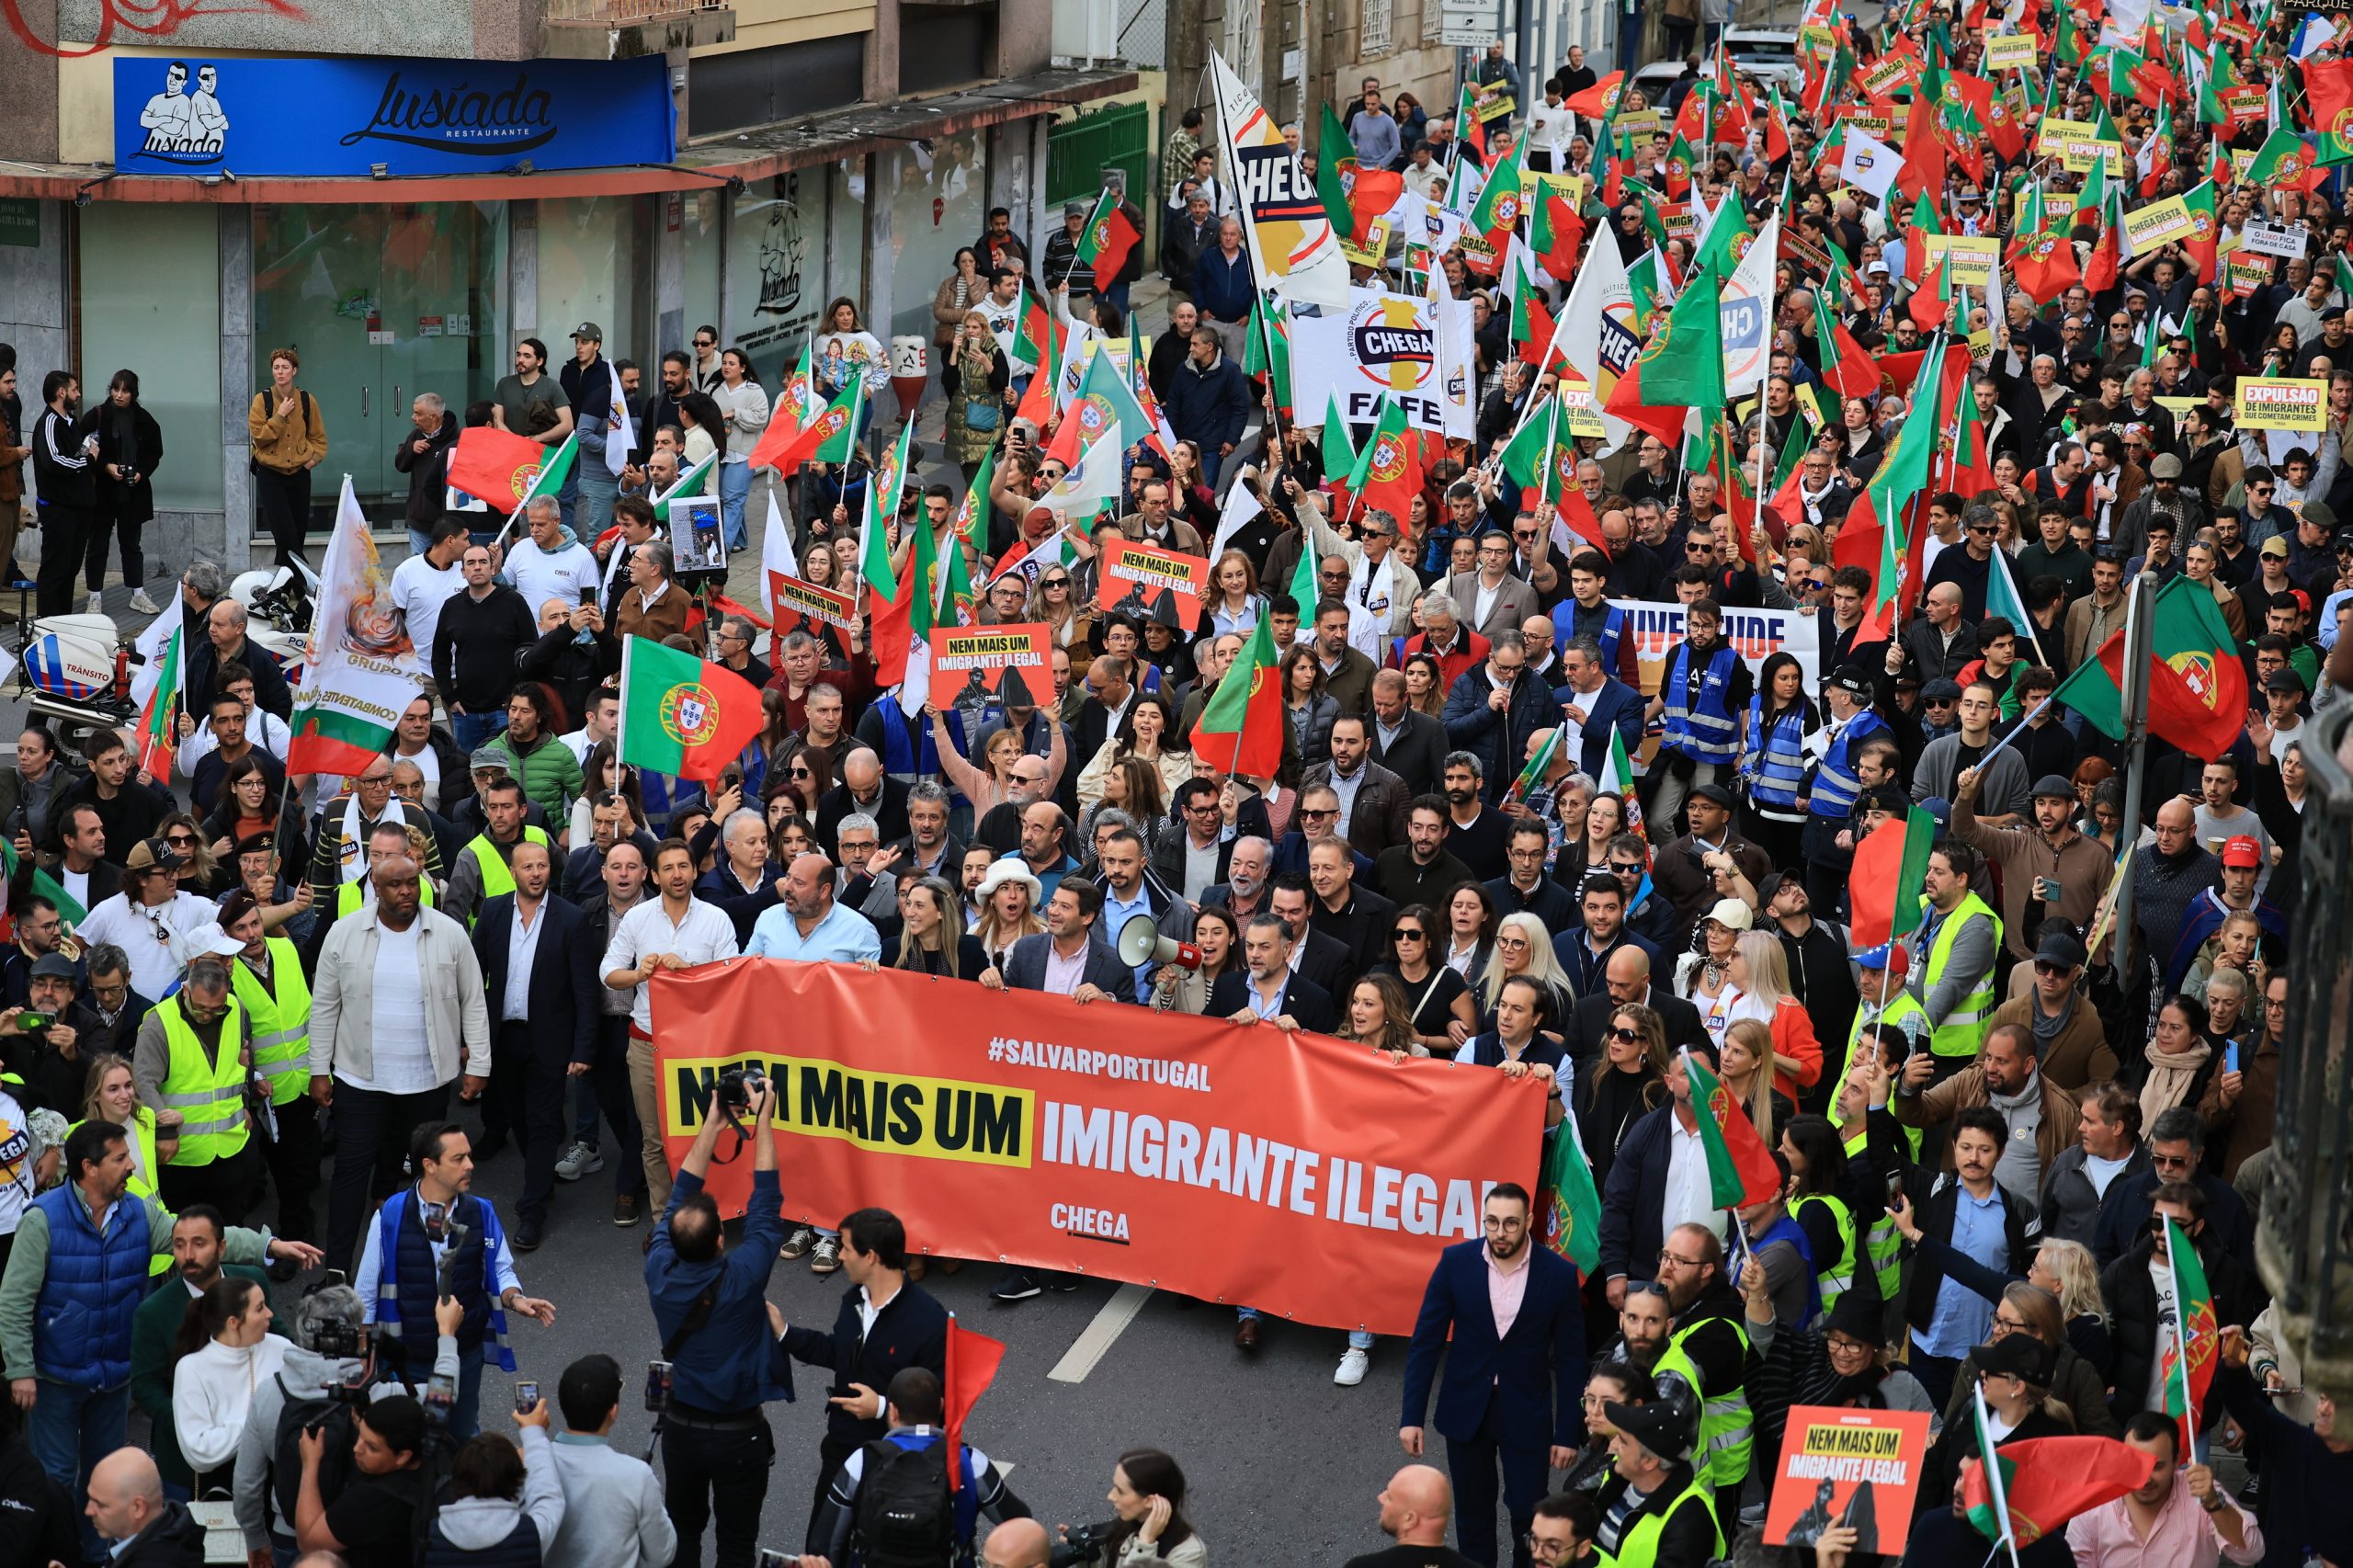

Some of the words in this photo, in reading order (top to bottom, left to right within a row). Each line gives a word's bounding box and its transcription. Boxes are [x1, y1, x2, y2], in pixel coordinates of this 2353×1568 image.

[447, 128, 529, 138] RESTAURANTE
[1440, 204, 1465, 220] CASCAIS
[2129, 219, 2155, 234] CHEGA
[2156, 208, 2182, 225] DESTA
[2251, 237, 2268, 246] FORA
[2278, 243, 2296, 251] CASA
[2262, 233, 2279, 241] LIXO
[2279, 235, 2296, 244] FICA
[1365, 332, 1434, 355] CHEGA
[1449, 380, 1465, 392] CHE
[2245, 385, 2318, 403] EXPULSÃO
[2245, 402, 2257, 412] DE
[2258, 403, 2316, 414] IMIGRANTES
[2258, 413, 2290, 421] COMETAM
[1123, 551, 1145, 568] NEM
[1145, 557, 1171, 574] MAIS
[1172, 563, 1189, 578] UM
[1109, 564, 1164, 588] IMIGRANTE
[1164, 575, 1197, 596] ILEGAL
[777, 594, 824, 621] IMIGRANTE
[784, 585, 804, 602] NEM
[805, 593, 826, 610] MAIS
[826, 600, 841, 615] UM
[1370, 596, 1388, 609] CHEGA
[949, 639, 976, 653] NEM
[978, 637, 1007, 653] MAIS
[1009, 636, 1029, 651] UM
[347, 653, 403, 676] GRUPO
[938, 654, 1005, 671] IMIGRANTE
[1005, 653, 1043, 667] ILEGAL
[66, 664, 109, 682] TRÂNSITO
[1707, 676, 1721, 686] CHEGA
[1842, 678, 1859, 688] CHEGA
[988, 1037, 1211, 1093] #SALVARPORTUGAL
[801, 1066, 925, 1146] MAIS
[934, 1087, 1023, 1157] UM
[1042, 1101, 1320, 1217] IMIGRANTE
[1051, 1202, 1130, 1241] CHEGA
[1806, 1428, 1836, 1450] NEM
[1838, 1430, 1874, 1454] MAIS
[1874, 1433, 1899, 1455] UM
[1787, 1454, 1862, 1482] IMIGRANTE
[1860, 1460, 1907, 1485] ILEGAL
